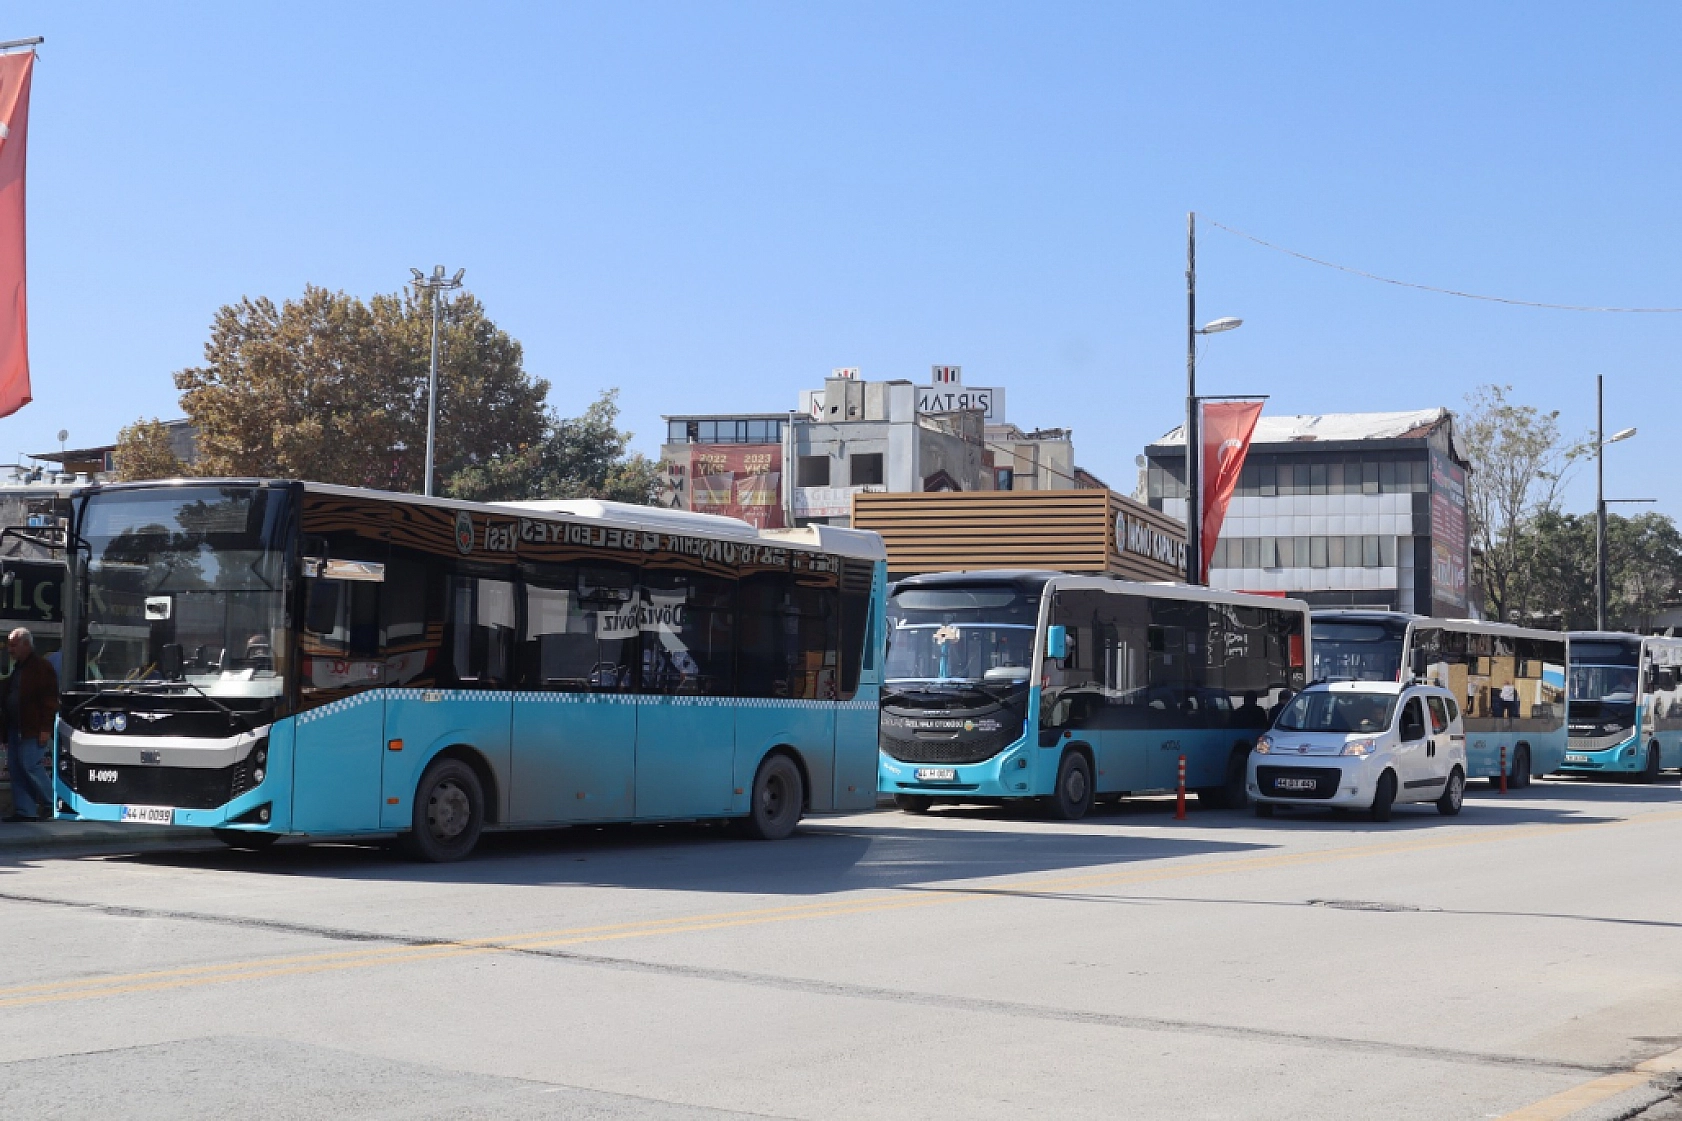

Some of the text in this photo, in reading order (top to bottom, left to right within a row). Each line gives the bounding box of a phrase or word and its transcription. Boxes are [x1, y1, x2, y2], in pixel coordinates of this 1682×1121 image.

[699, 453, 727, 463] 2022
[743, 453, 772, 463] 2023
[744, 463, 771, 475] YKS
[89, 769, 119, 783] H-0099
[126, 808, 171, 821] 44 H 0099
